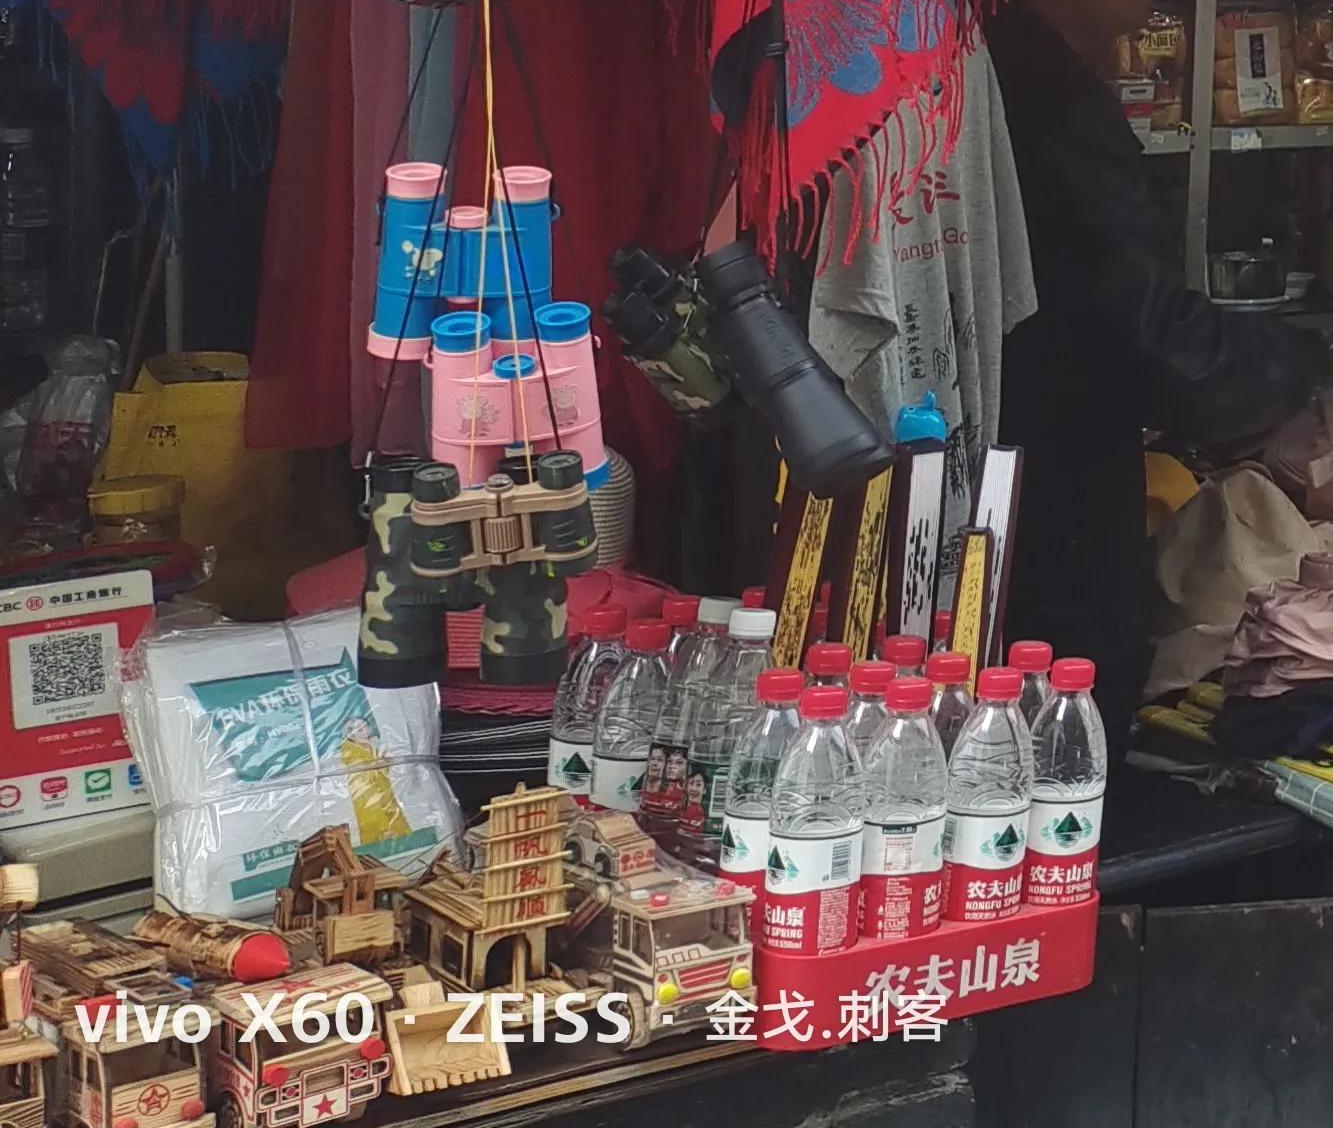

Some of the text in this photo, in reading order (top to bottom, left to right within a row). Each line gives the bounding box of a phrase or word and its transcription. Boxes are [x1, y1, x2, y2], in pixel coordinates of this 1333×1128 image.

[50, 586, 122, 605] 中国工商银行
[1030, 862, 1094, 884] 农夫山泉
[965, 899, 1002, 911] NONGFU
[771, 927, 803, 939] SPRING
[864, 937, 1042, 1018] 农夫山泉
